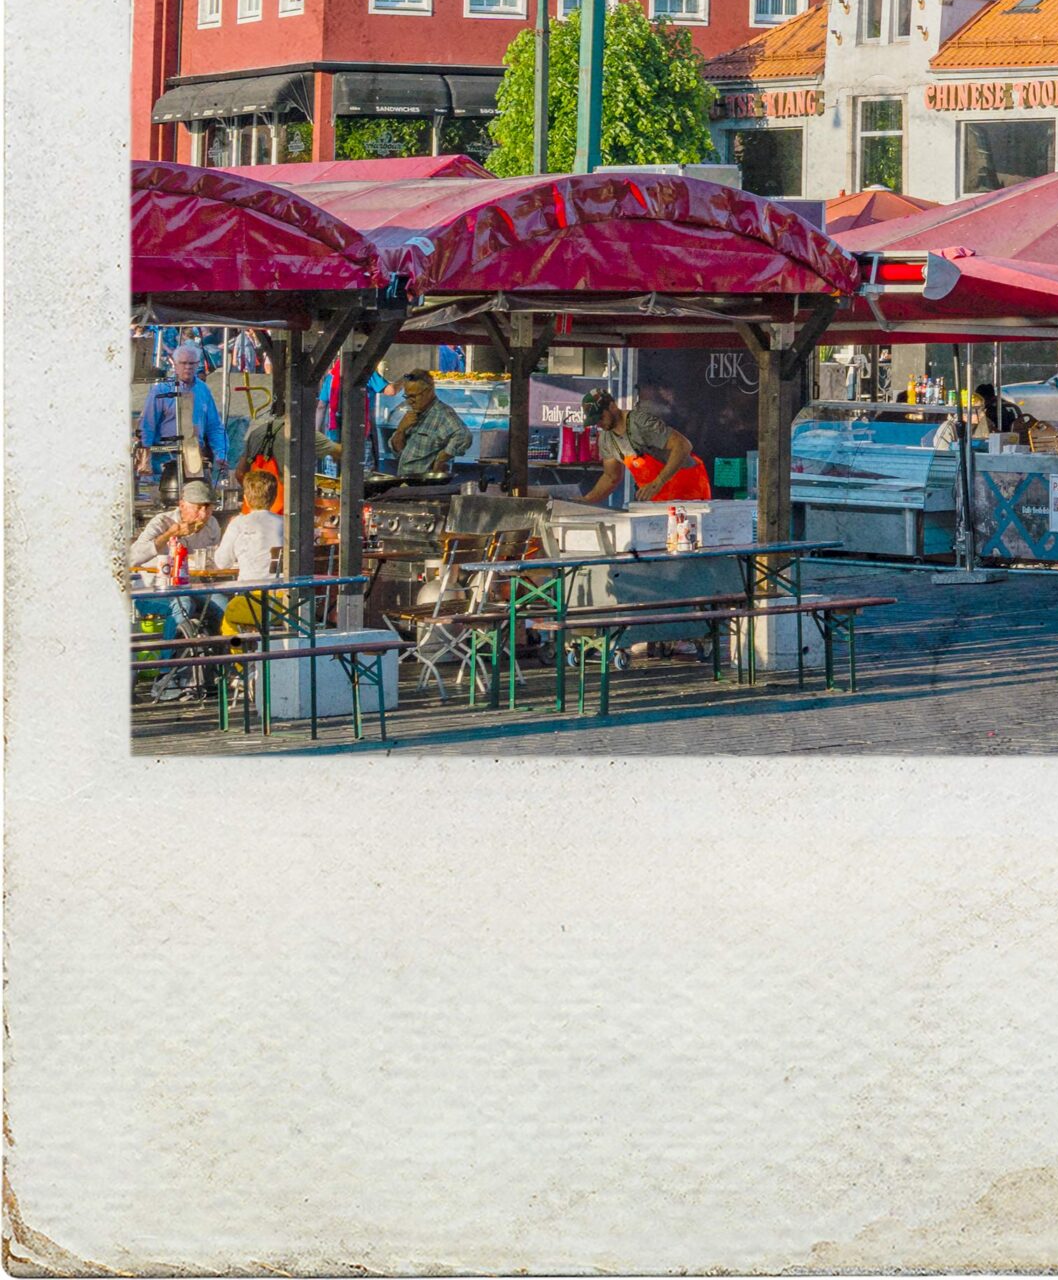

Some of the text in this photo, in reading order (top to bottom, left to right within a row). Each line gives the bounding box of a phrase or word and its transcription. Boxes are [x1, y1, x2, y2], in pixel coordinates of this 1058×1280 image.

[725, 93, 757, 118] TSE
[761, 90, 820, 117] KIANG
[923, 81, 1008, 112] CHINESE
[706, 352, 752, 383] FISK
[542, 404, 564, 426] Daily
